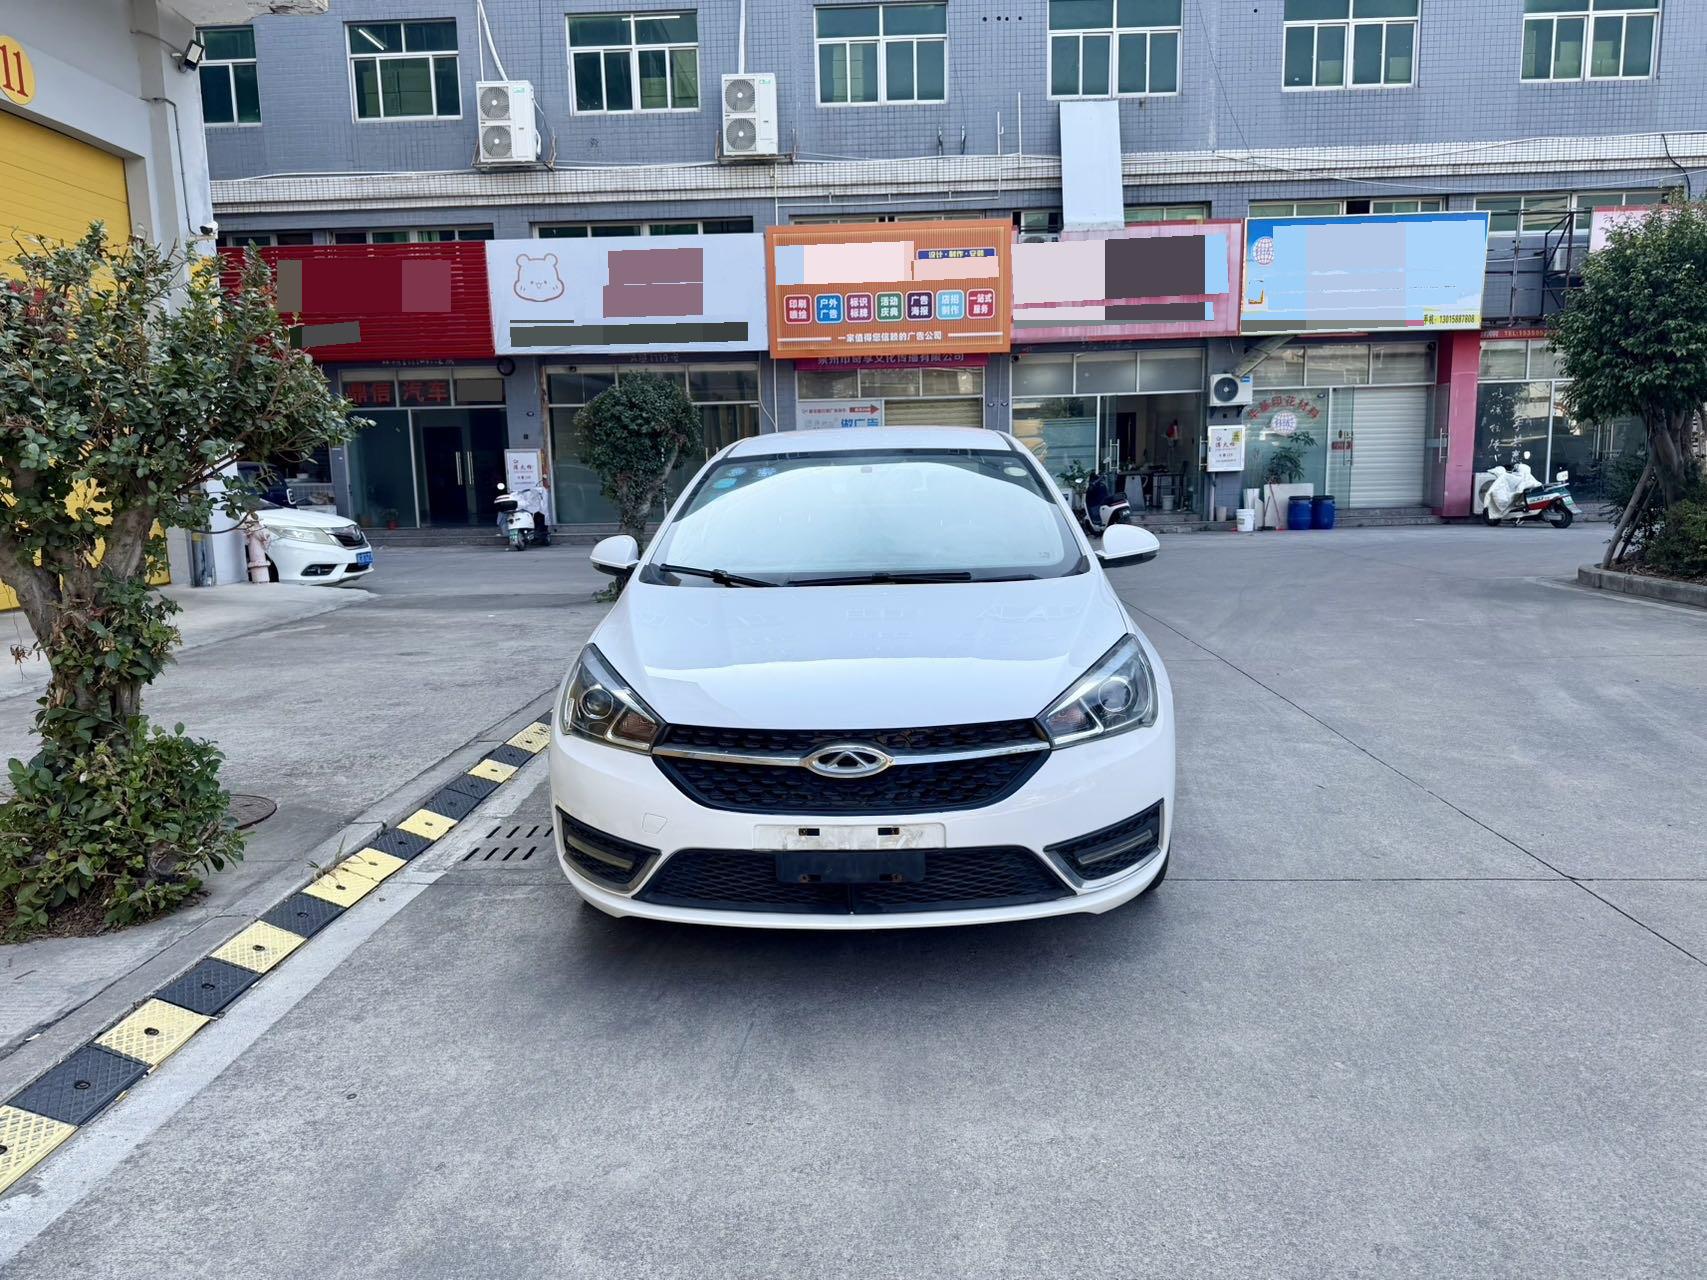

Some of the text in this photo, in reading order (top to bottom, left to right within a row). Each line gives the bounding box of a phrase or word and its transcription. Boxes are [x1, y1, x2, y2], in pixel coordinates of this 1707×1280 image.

[0, 45, 29, 97] 11
[819, 298, 838, 308] 户外
[849, 297, 869, 307] 标识
[880, 296, 898, 306] 活动
[910, 295, 929, 305] 广告
[969, 293, 992, 303] 一站式
[788, 298, 807, 309] 印刷
[819, 309, 837, 319] 广告
[850, 307, 869, 318] 标牌
[880, 307, 899, 317] 庆典
[911, 306, 929, 316] 海报
[972, 304, 989, 314] 服务
[838, 330, 942, 343] 一家值得您信赖的广告公司
[402, 380, 449, 403] 汽车
